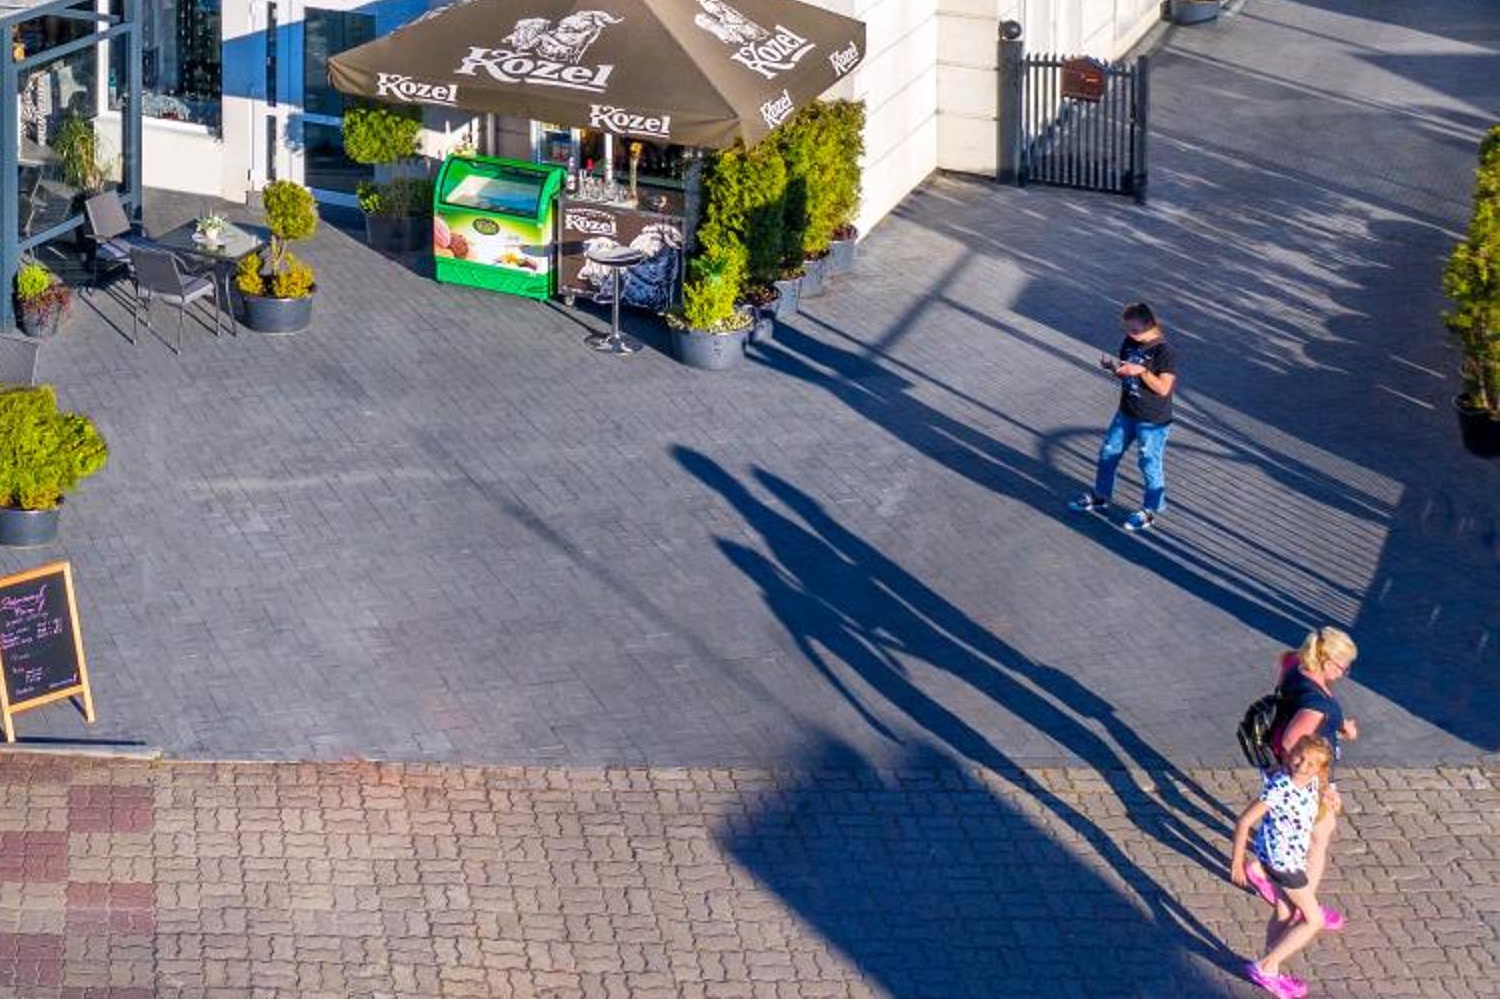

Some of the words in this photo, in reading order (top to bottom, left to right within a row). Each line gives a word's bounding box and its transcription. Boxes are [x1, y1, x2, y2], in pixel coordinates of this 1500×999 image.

[454, 46, 614, 93] Kozel
[730, 24, 817, 80] Kozel
[829, 41, 860, 76] Kozel
[376, 72, 458, 106] Kozel
[589, 104, 671, 138] Kozel
[760, 89, 794, 130] Kozel
[565, 214, 617, 236] Kozel
